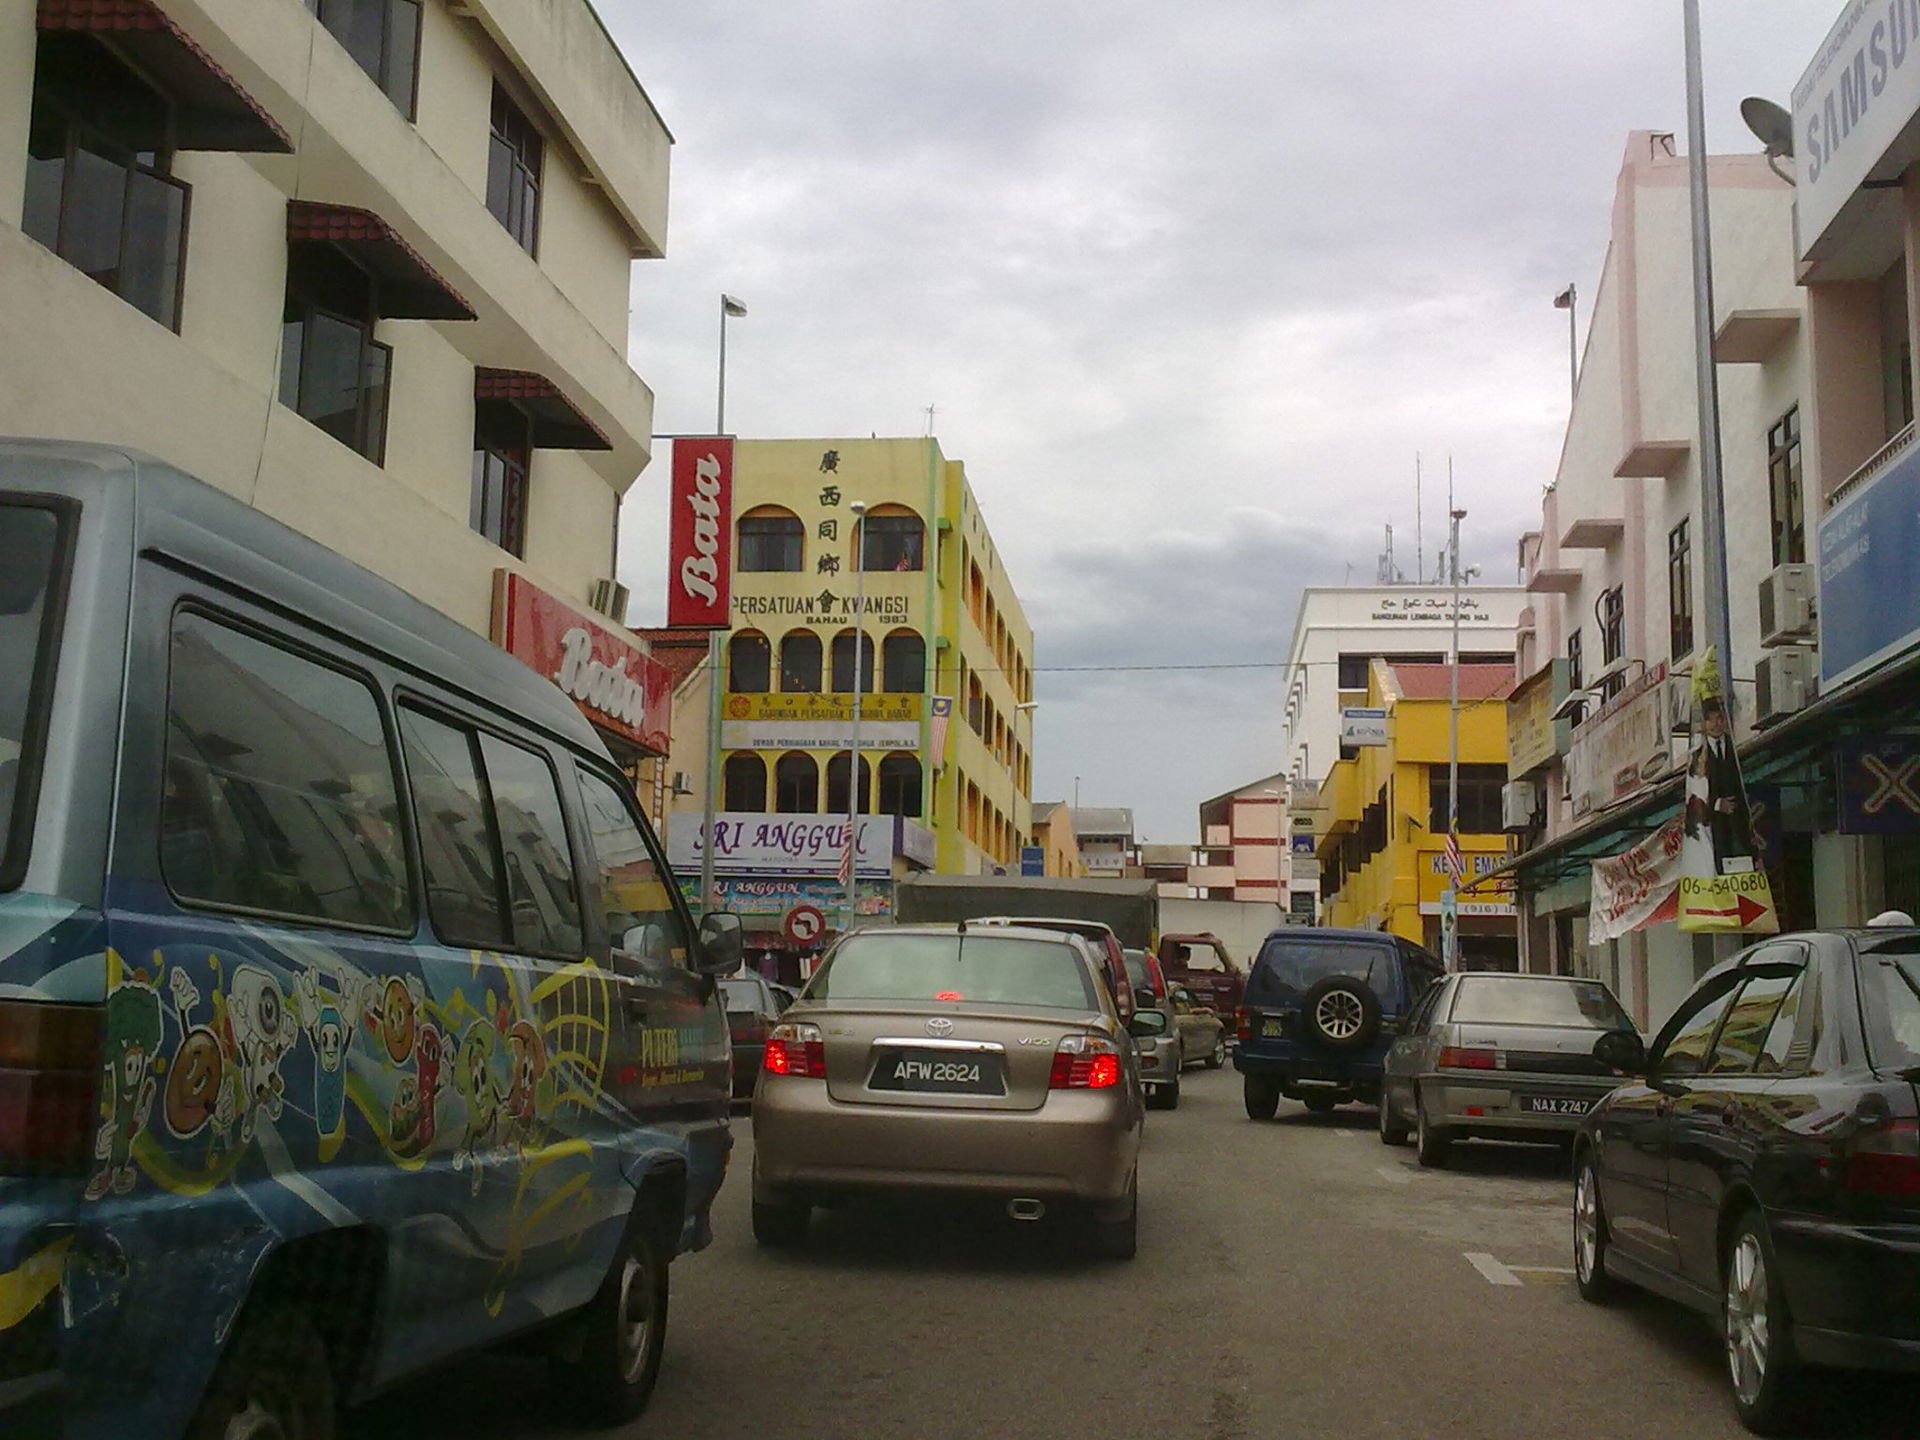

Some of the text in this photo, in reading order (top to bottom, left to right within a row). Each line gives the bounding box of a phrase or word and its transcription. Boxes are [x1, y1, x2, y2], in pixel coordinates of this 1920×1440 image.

[681, 452, 722, 608] Bata
[806, 615, 908, 624] BAHAU 1983
[553, 627, 645, 729] Bata
[1432, 855, 1469, 873] KEI
[894, 1062, 981, 1082] AFW2624
[1532, 1098, 1590, 1114] NAX 2747
